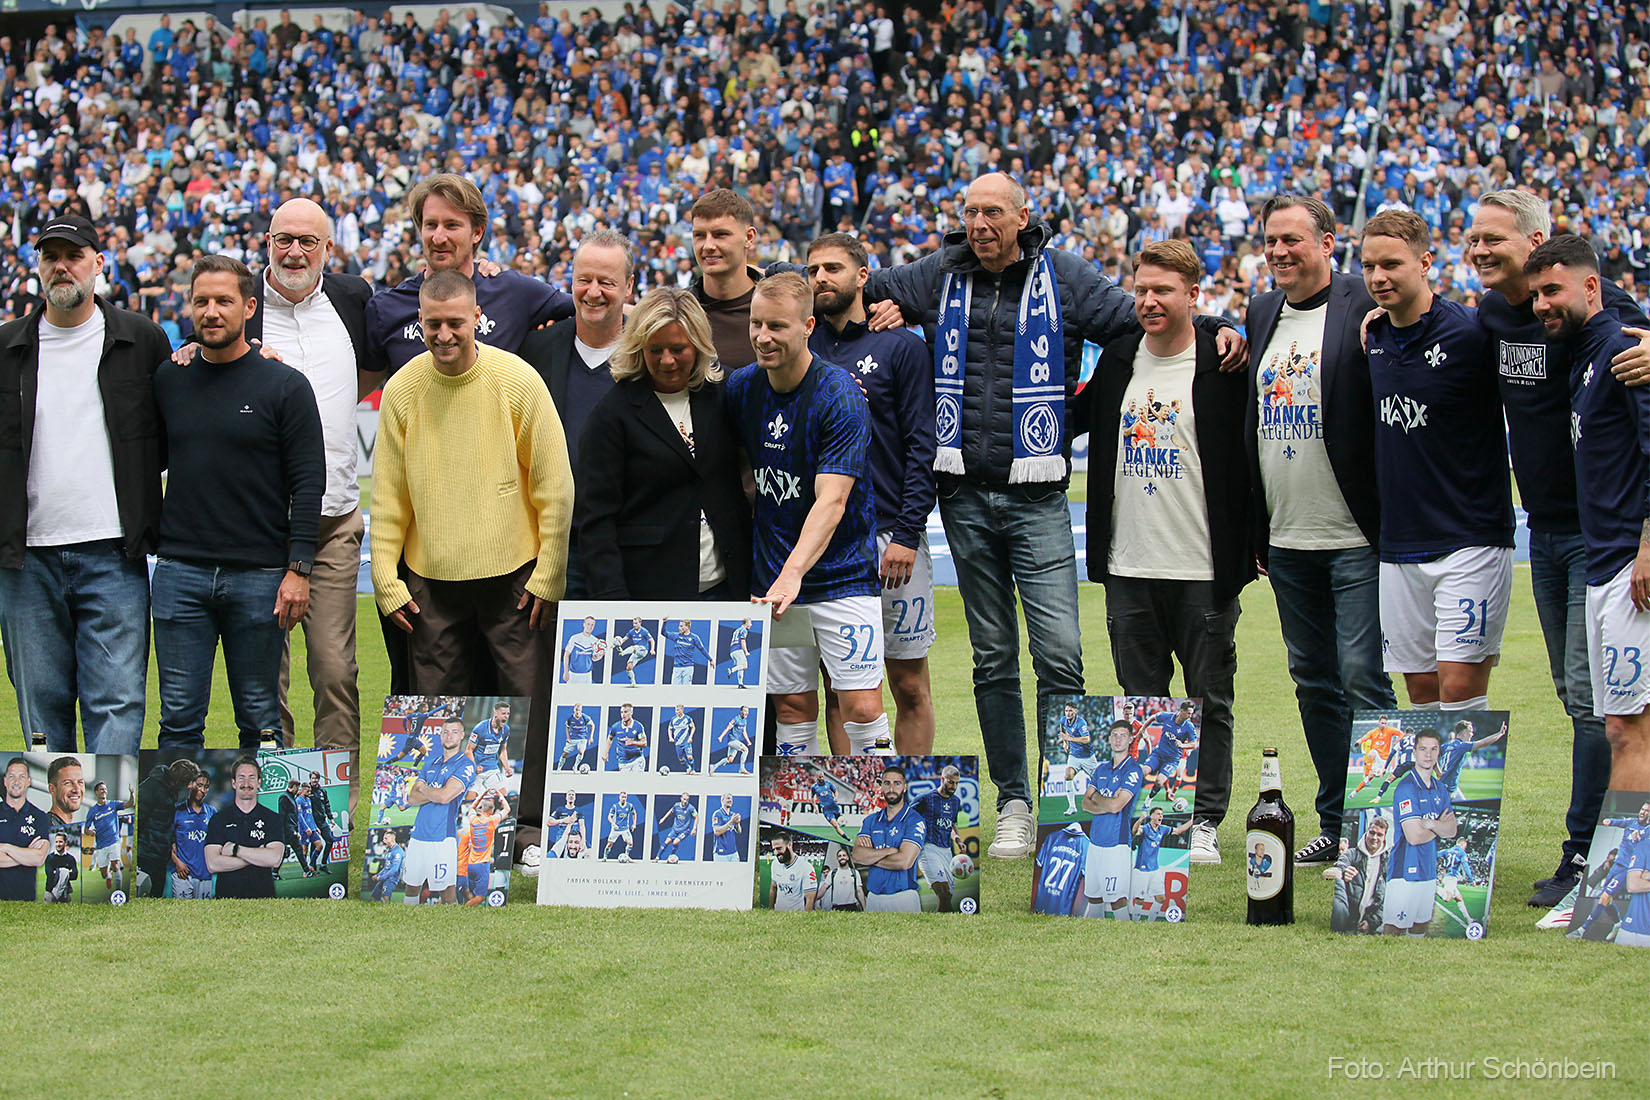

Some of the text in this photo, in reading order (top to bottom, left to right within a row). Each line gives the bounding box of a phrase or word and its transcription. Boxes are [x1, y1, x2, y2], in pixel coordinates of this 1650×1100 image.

[1030, 334, 1050, 384] 98
[1512, 365, 1522, 375] LA
[1264, 405, 1319, 426] DANKE
[1261, 422, 1325, 441] LEGENDE
[1125, 446, 1180, 466] DANKE
[1123, 462, 1184, 480] LEGENDE
[892, 596, 928, 635] 22
[1455, 598, 1488, 637] 31
[840, 624, 878, 662] 32
[899, 635, 921, 643] CRAFT
[1456, 637, 1479, 646] CRAFT
[850, 663, 873, 671] CRAFT
[1606, 646, 1642, 688] 23
[472, 828, 488, 847] 15
[434, 863, 447, 880] 15
[1044, 856, 1075, 891] 27
[1105, 876, 1117, 892] 27
